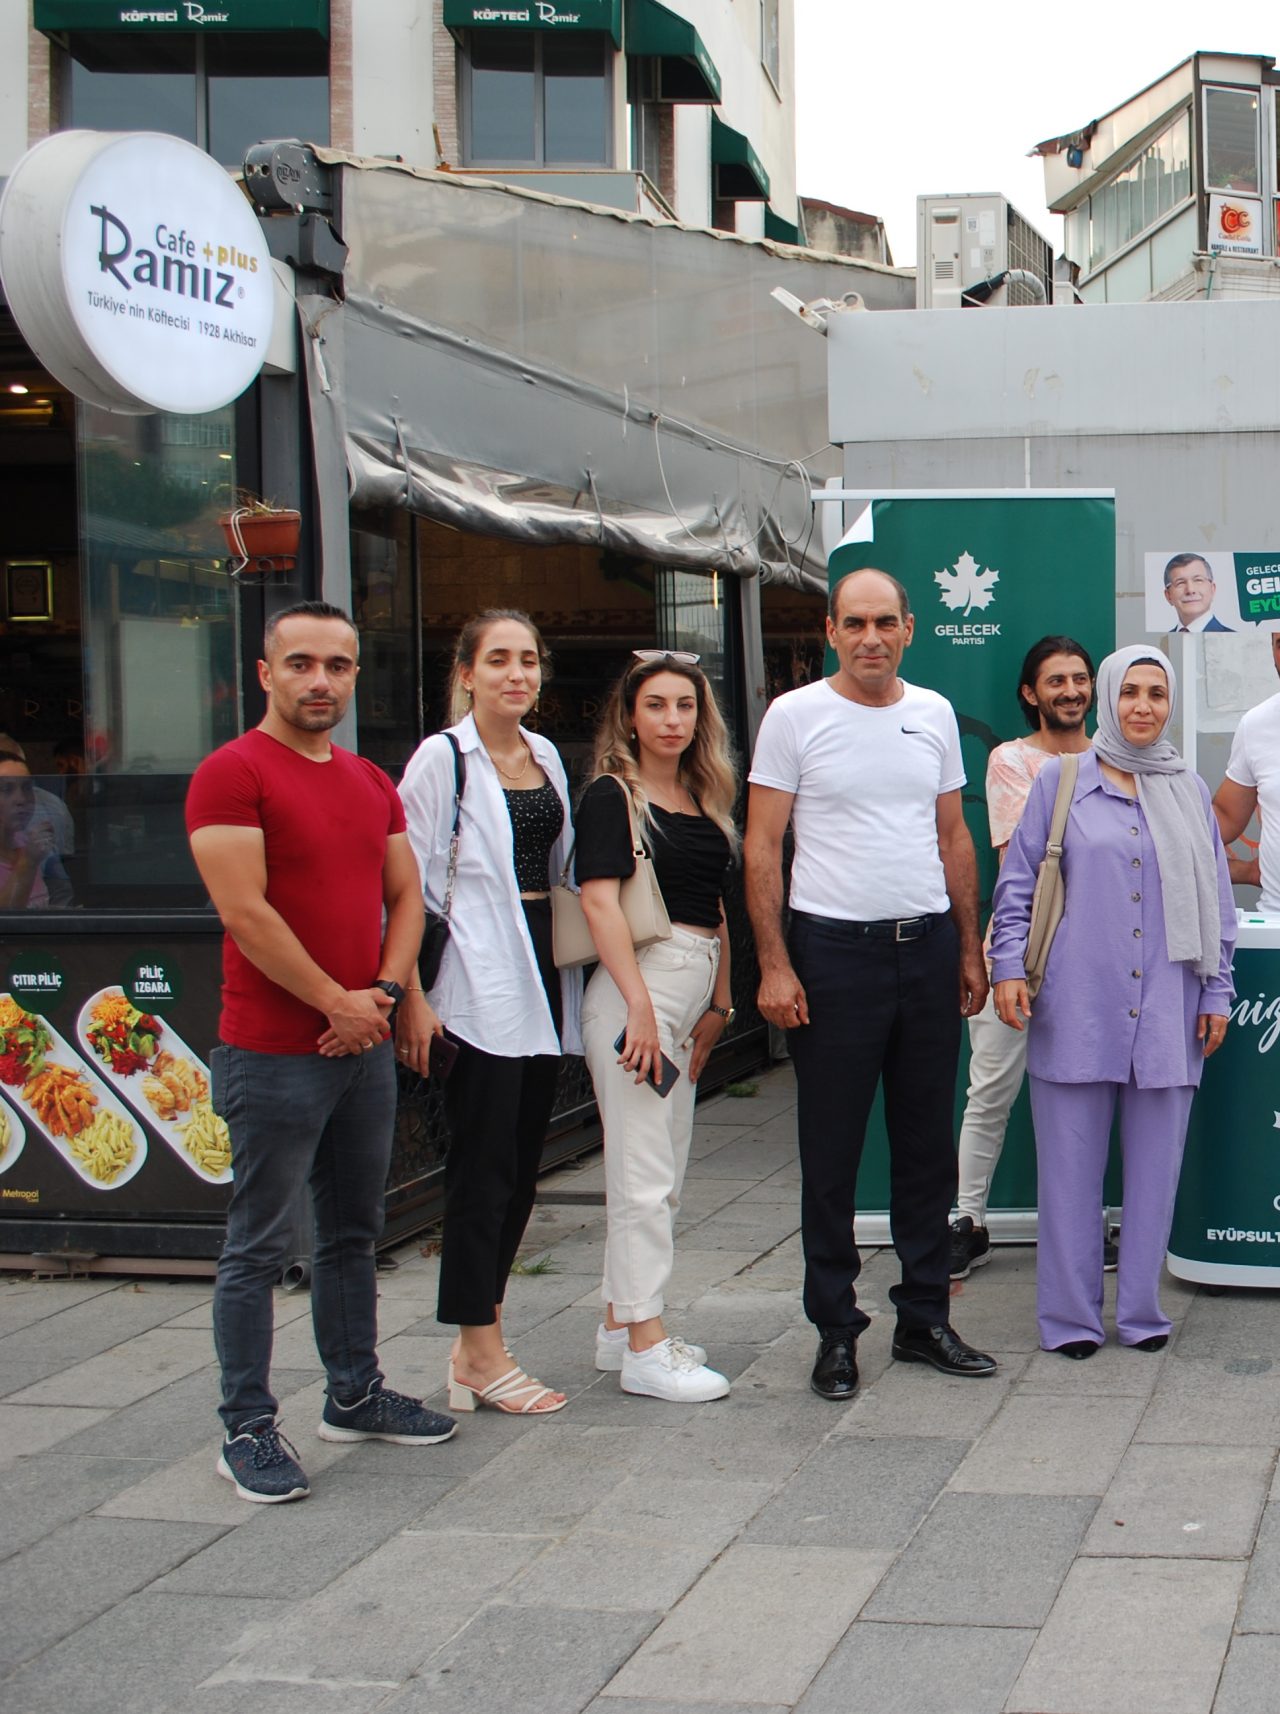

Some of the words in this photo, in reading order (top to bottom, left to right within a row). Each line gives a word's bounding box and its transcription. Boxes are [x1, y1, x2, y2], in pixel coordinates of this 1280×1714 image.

[155, 224, 196, 258] Cafe
[934, 623, 1002, 636] GELECEK
[139, 964, 164, 981] PİLİÇ
[135, 982, 172, 993] IZGARA
